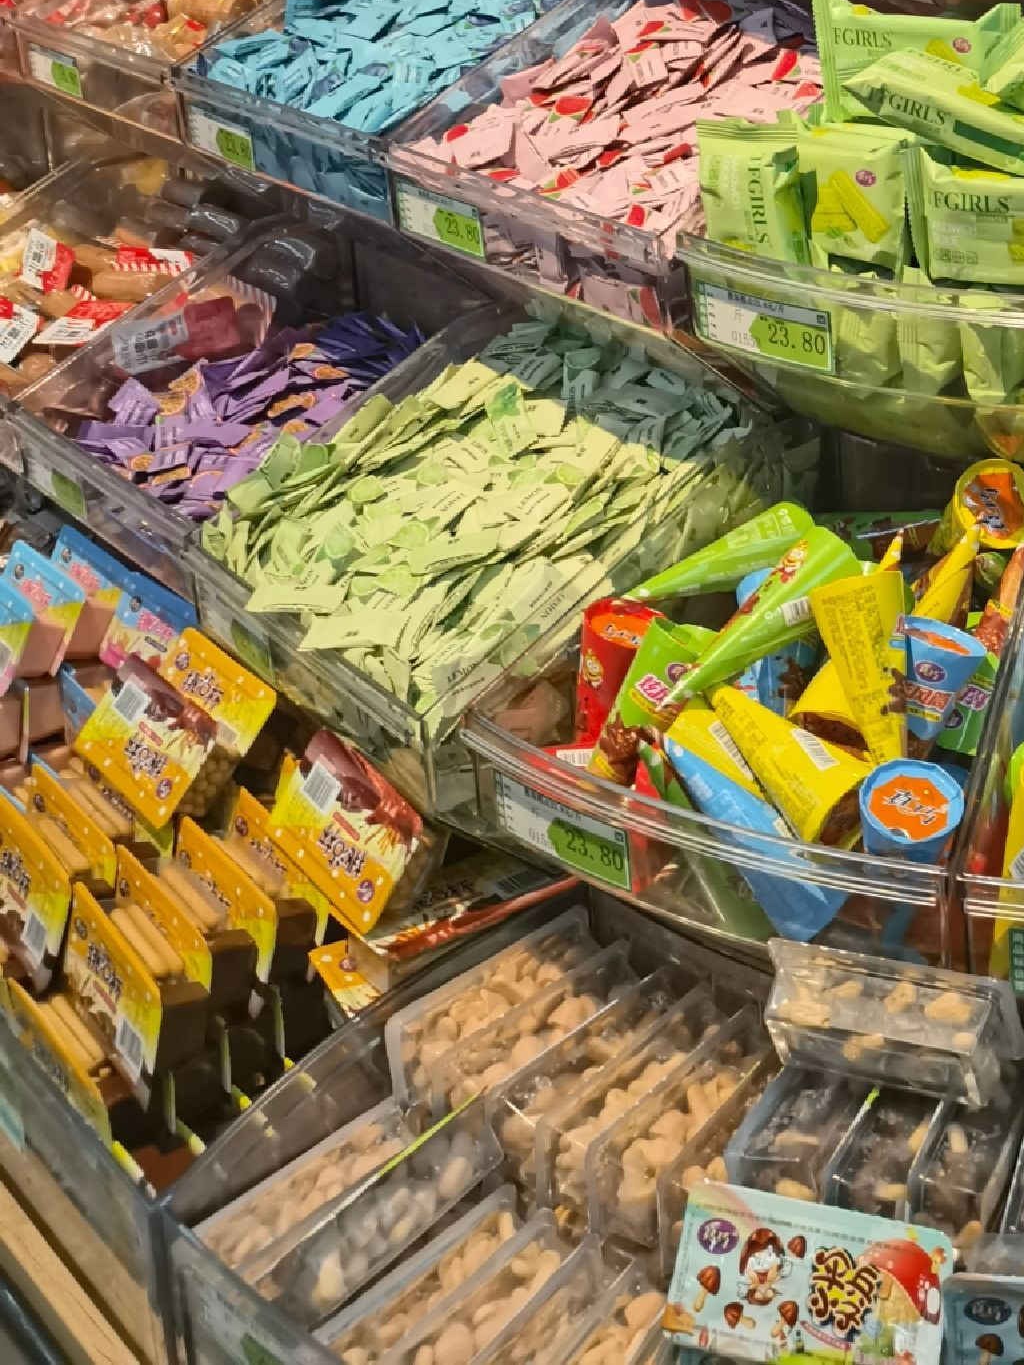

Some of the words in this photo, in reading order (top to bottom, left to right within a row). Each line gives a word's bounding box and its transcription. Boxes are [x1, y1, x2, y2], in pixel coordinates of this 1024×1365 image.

[444, 216, 480, 245] 23.80
[767, 322, 827, 356] 23.80
[565, 827, 625, 873] 23.80
